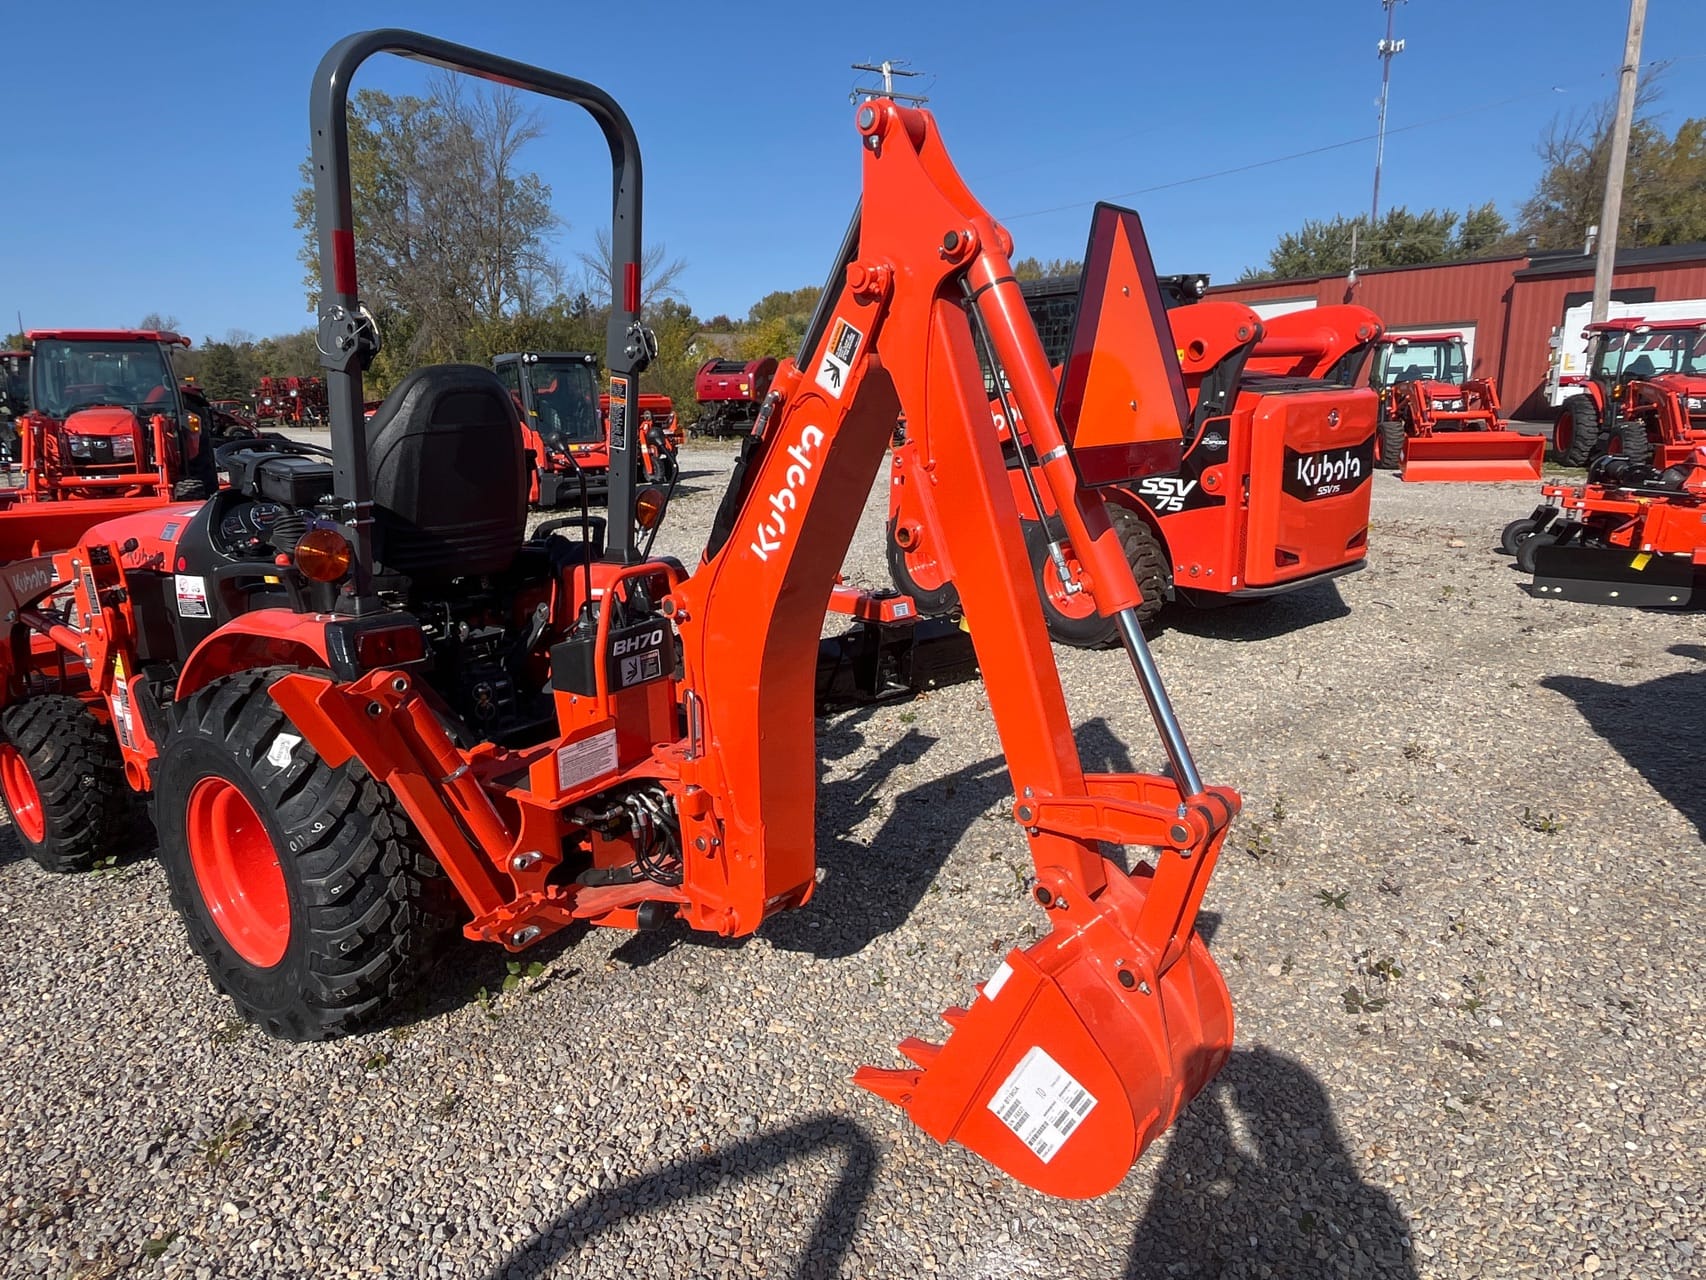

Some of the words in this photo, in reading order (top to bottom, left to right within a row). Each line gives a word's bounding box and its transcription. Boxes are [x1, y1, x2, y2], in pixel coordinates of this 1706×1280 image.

[1297, 450, 1361, 486] Kubota
[750, 424, 825, 562] Kubota
[1138, 477, 1198, 497] SSV
[1154, 495, 1185, 512] 75
[12, 566, 48, 593] Kubota
[613, 630, 663, 657] BH70
